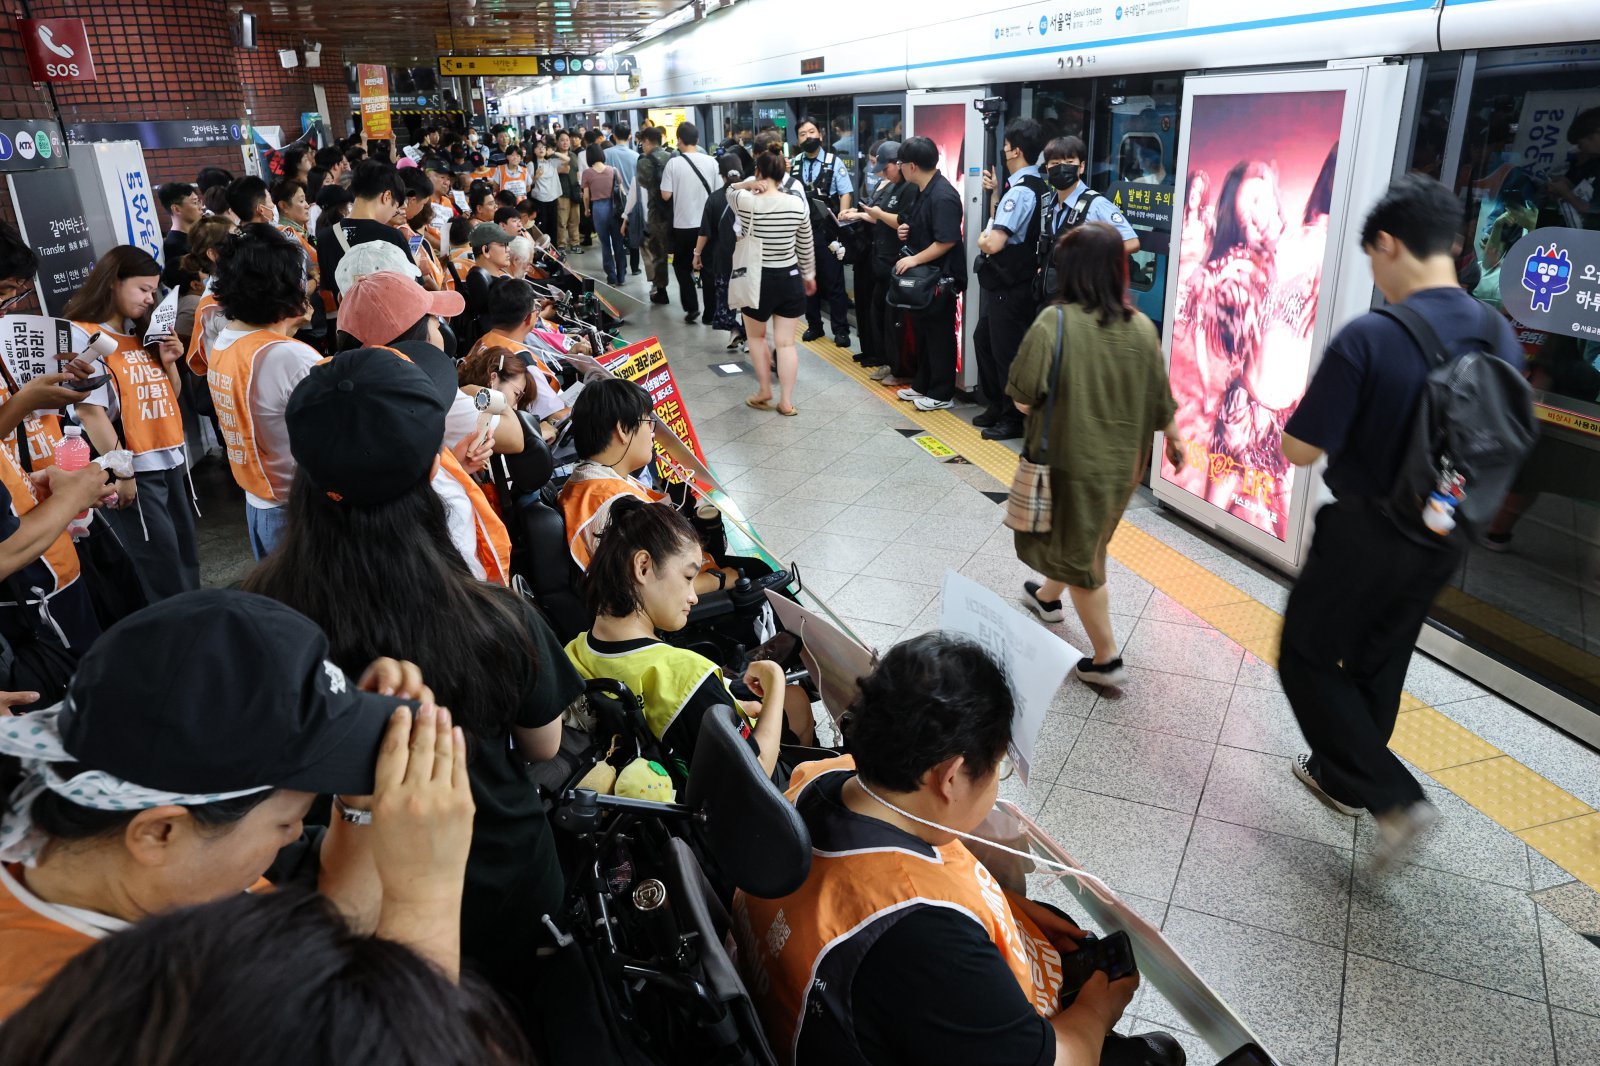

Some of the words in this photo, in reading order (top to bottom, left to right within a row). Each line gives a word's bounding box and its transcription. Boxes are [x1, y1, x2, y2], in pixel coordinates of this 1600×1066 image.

[1073, 9, 1086, 18] Seoul
[1086, 7, 1102, 16] Station
[1050, 12, 1072, 32] 서울역
[46, 63, 80, 77] SOS
[191, 124, 219, 135] 갈아타는
[221, 124, 227, 134] 곳
[19, 141, 33, 150] KTX
[1128, 188, 1151, 204] 발빠짐
[49, 216, 81, 238] 갈아타는
[38, 243, 66, 256] Transfer
[53, 272, 66, 284] 연천
[30, 329, 45, 358] 하라!
[1547, 411, 1572, 425] 비상시
[1243, 466, 1275, 506] LIFE
